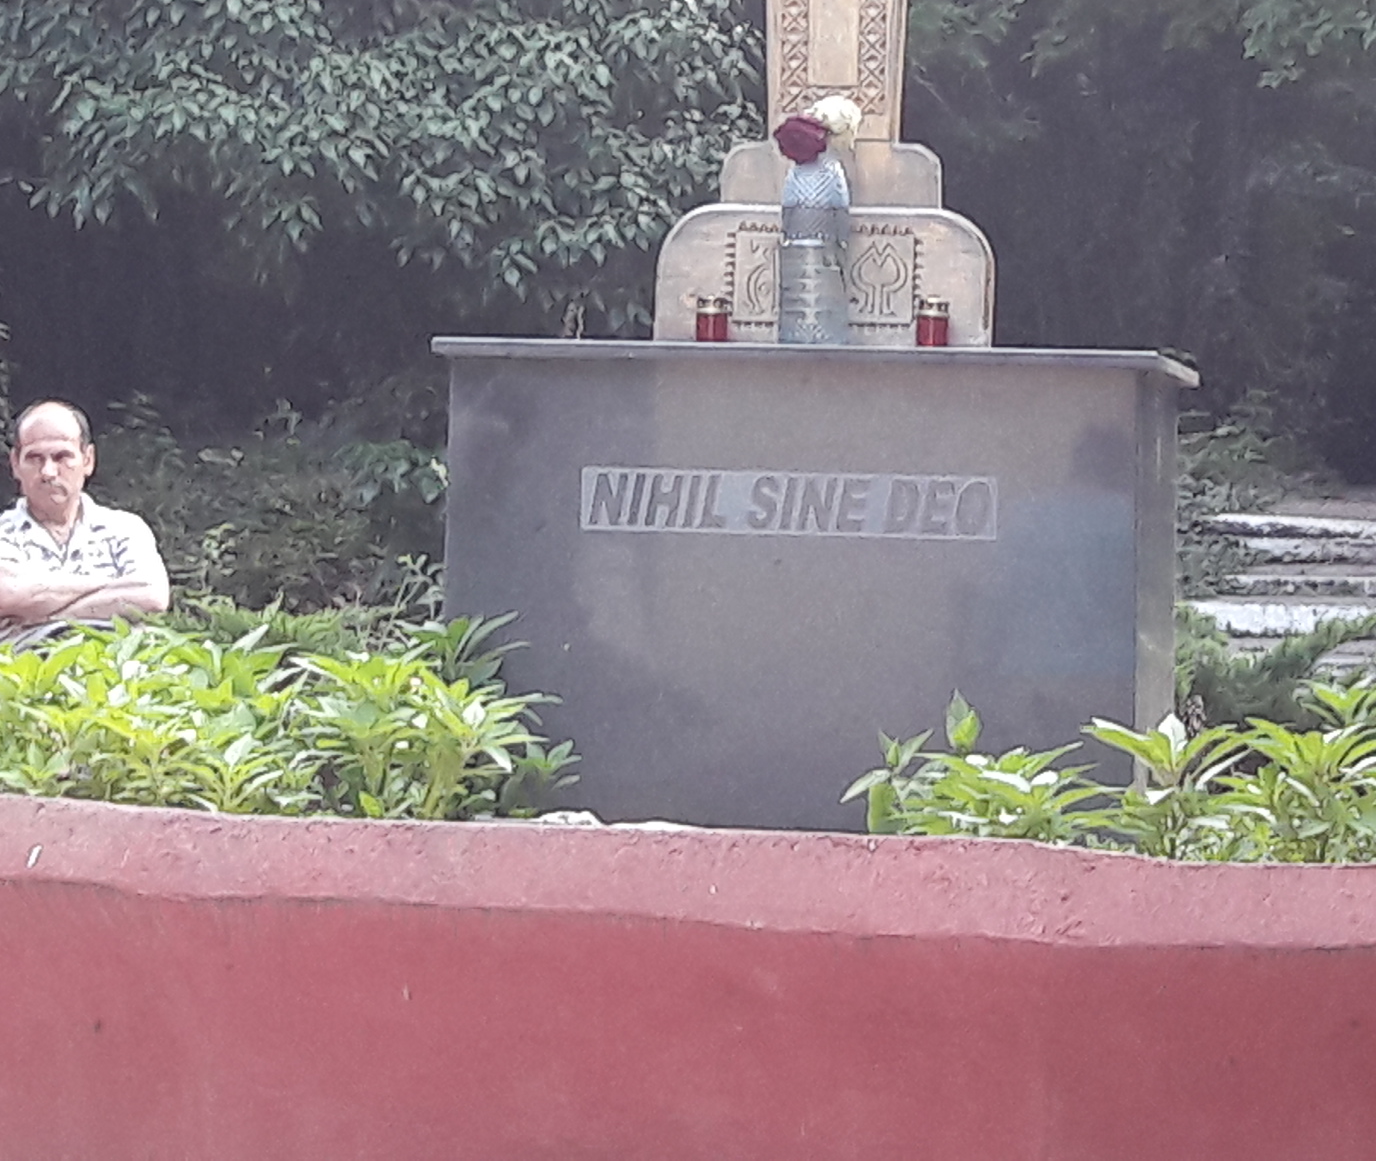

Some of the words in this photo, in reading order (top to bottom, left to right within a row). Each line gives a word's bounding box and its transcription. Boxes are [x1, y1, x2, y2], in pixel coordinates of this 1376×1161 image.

[587, 472, 727, 528] NIHIL
[746, 475, 872, 533] SINE
[882, 479, 995, 536] DEO
